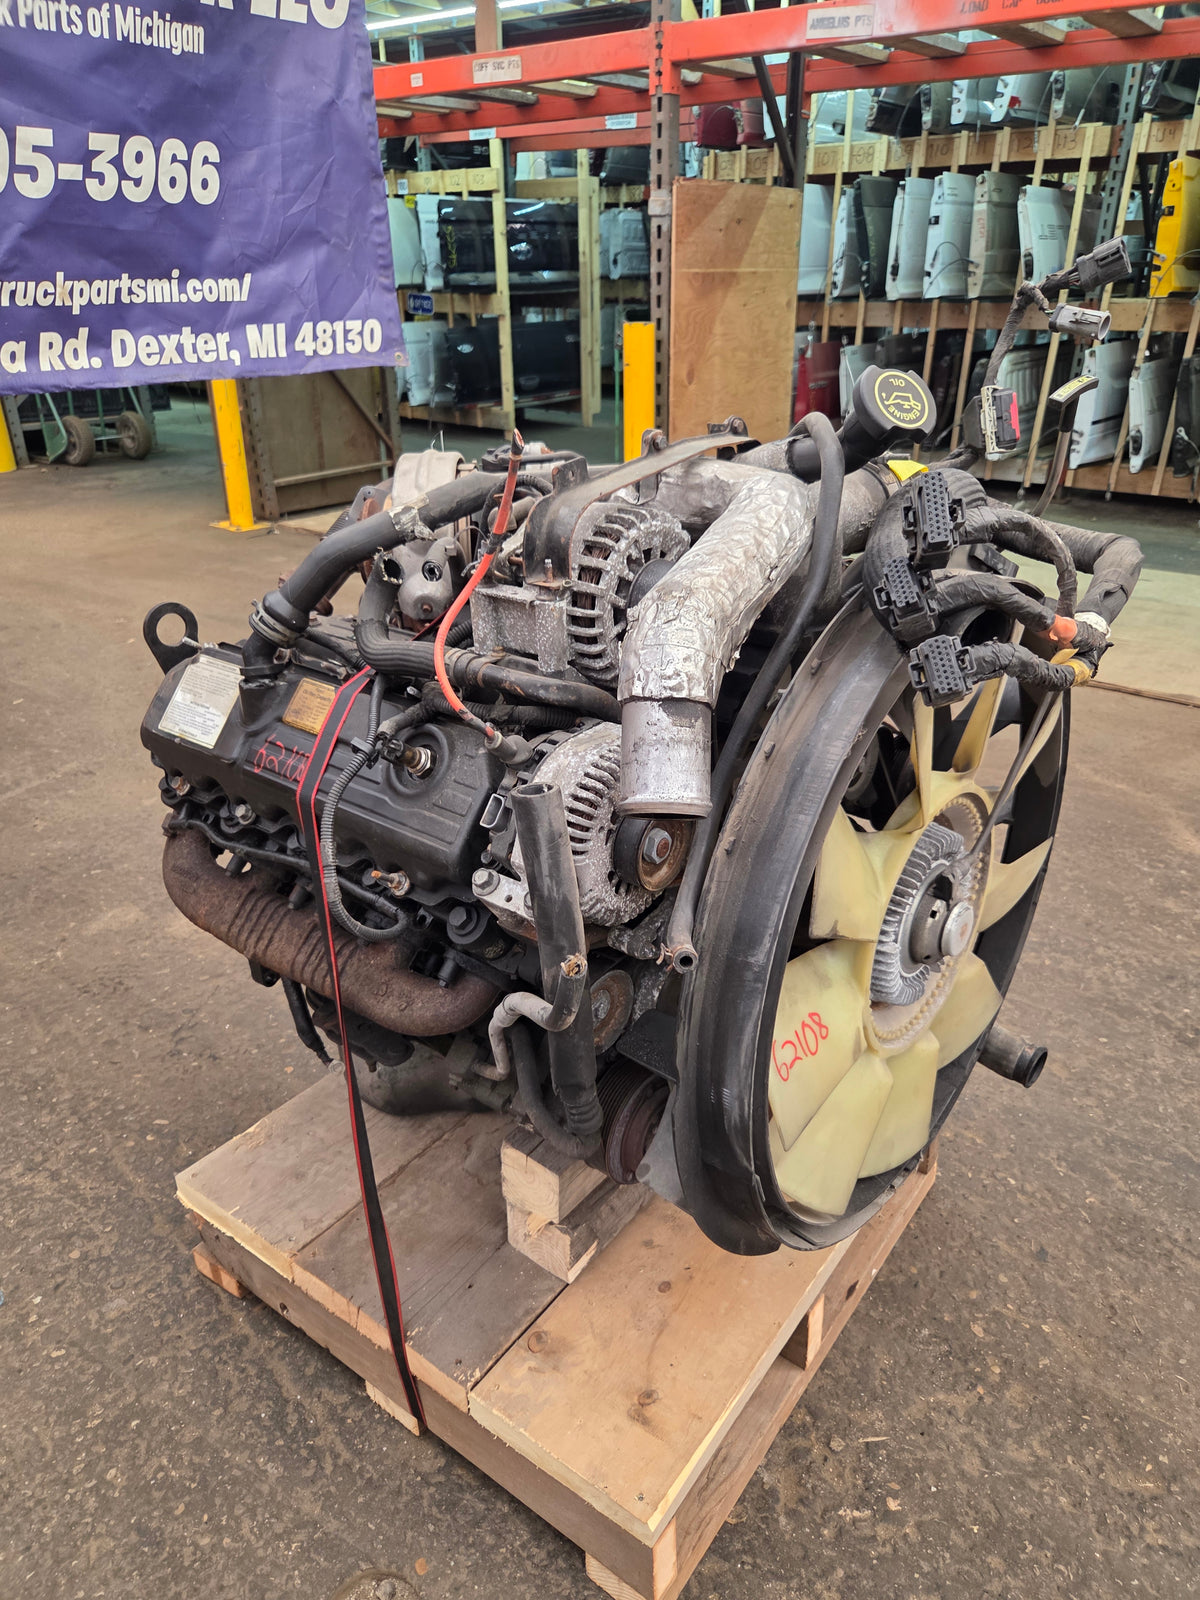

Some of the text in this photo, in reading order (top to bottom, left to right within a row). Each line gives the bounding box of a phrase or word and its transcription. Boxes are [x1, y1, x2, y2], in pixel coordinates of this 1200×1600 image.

[18, 0, 83, 35] Parts
[87, 3, 109, 39] of
[115, 3, 205, 55] Michigan
[0, 126, 220, 205] 5-3966
[0, 269, 251, 315] ruckpartsmi.com/
[39, 327, 102, 371] Rd.
[112, 327, 240, 366] Dexter,
[246, 323, 287, 358] MI
[295, 319, 382, 356] 48130
[888, 378, 920, 420] ENGINE OIL
[773, 1012, 829, 1082] 62108
